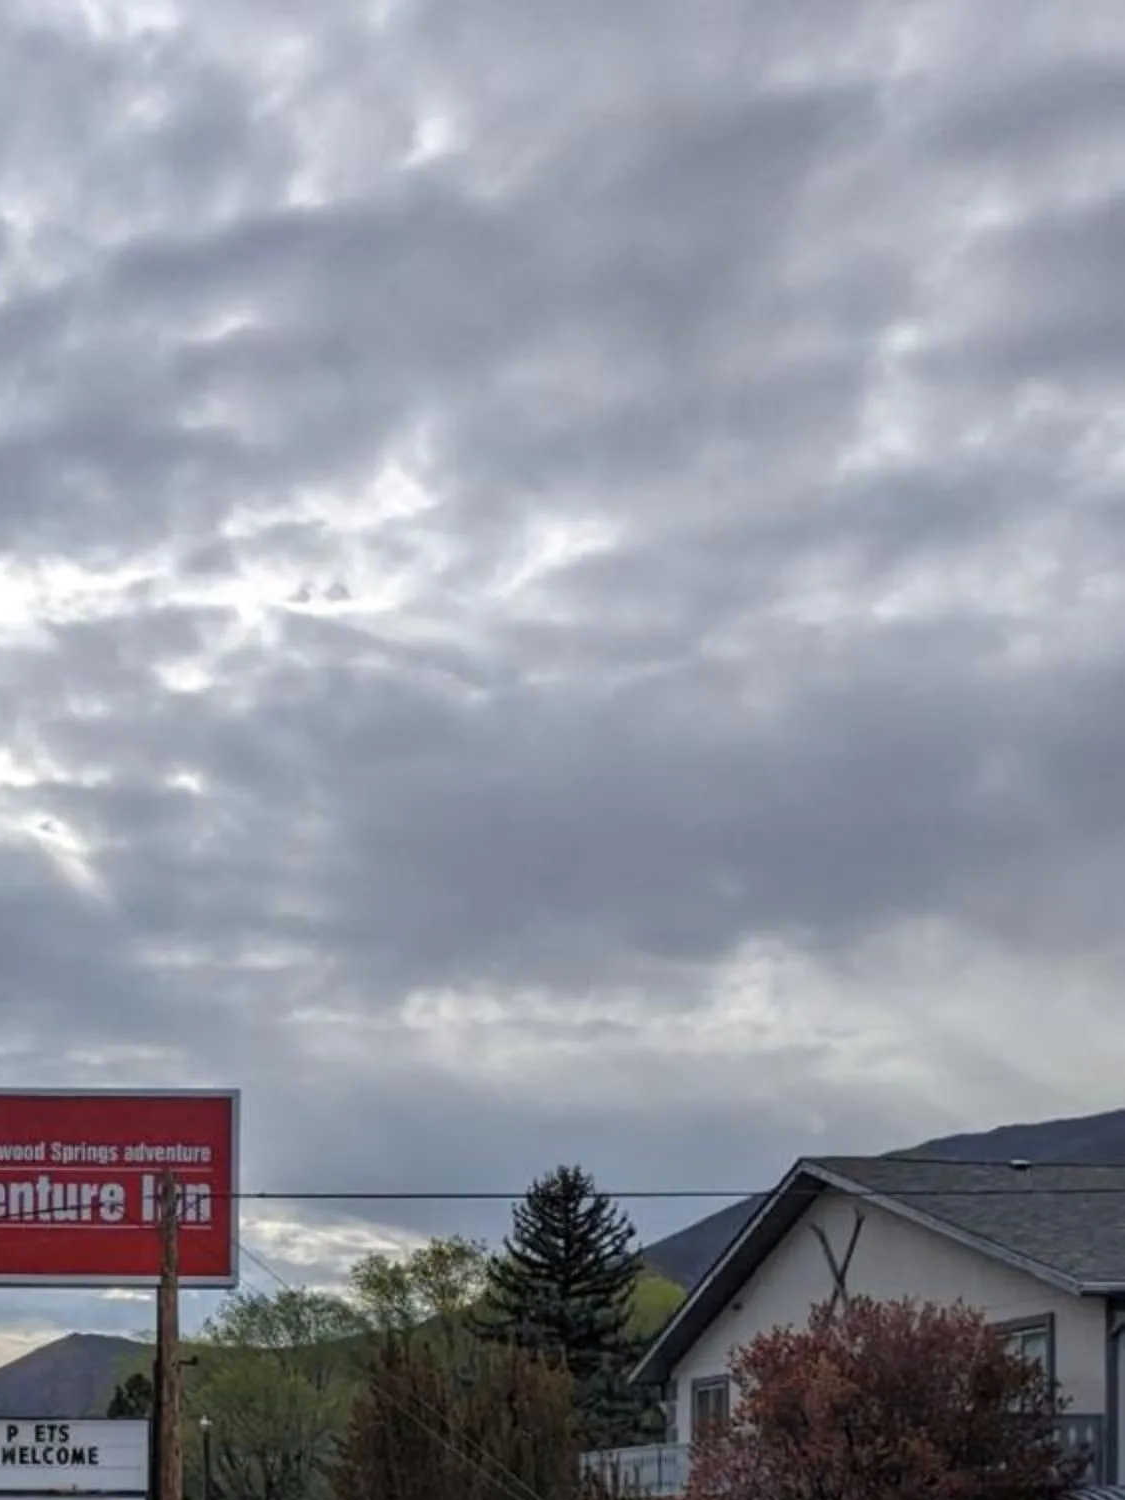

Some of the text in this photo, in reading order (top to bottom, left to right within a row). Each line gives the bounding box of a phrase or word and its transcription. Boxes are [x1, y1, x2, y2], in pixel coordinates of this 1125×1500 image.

[51, 1141, 119, 1164] Springs
[124, 1142, 212, 1163] adventure
[1, 1447, 99, 1465] WELCOME
